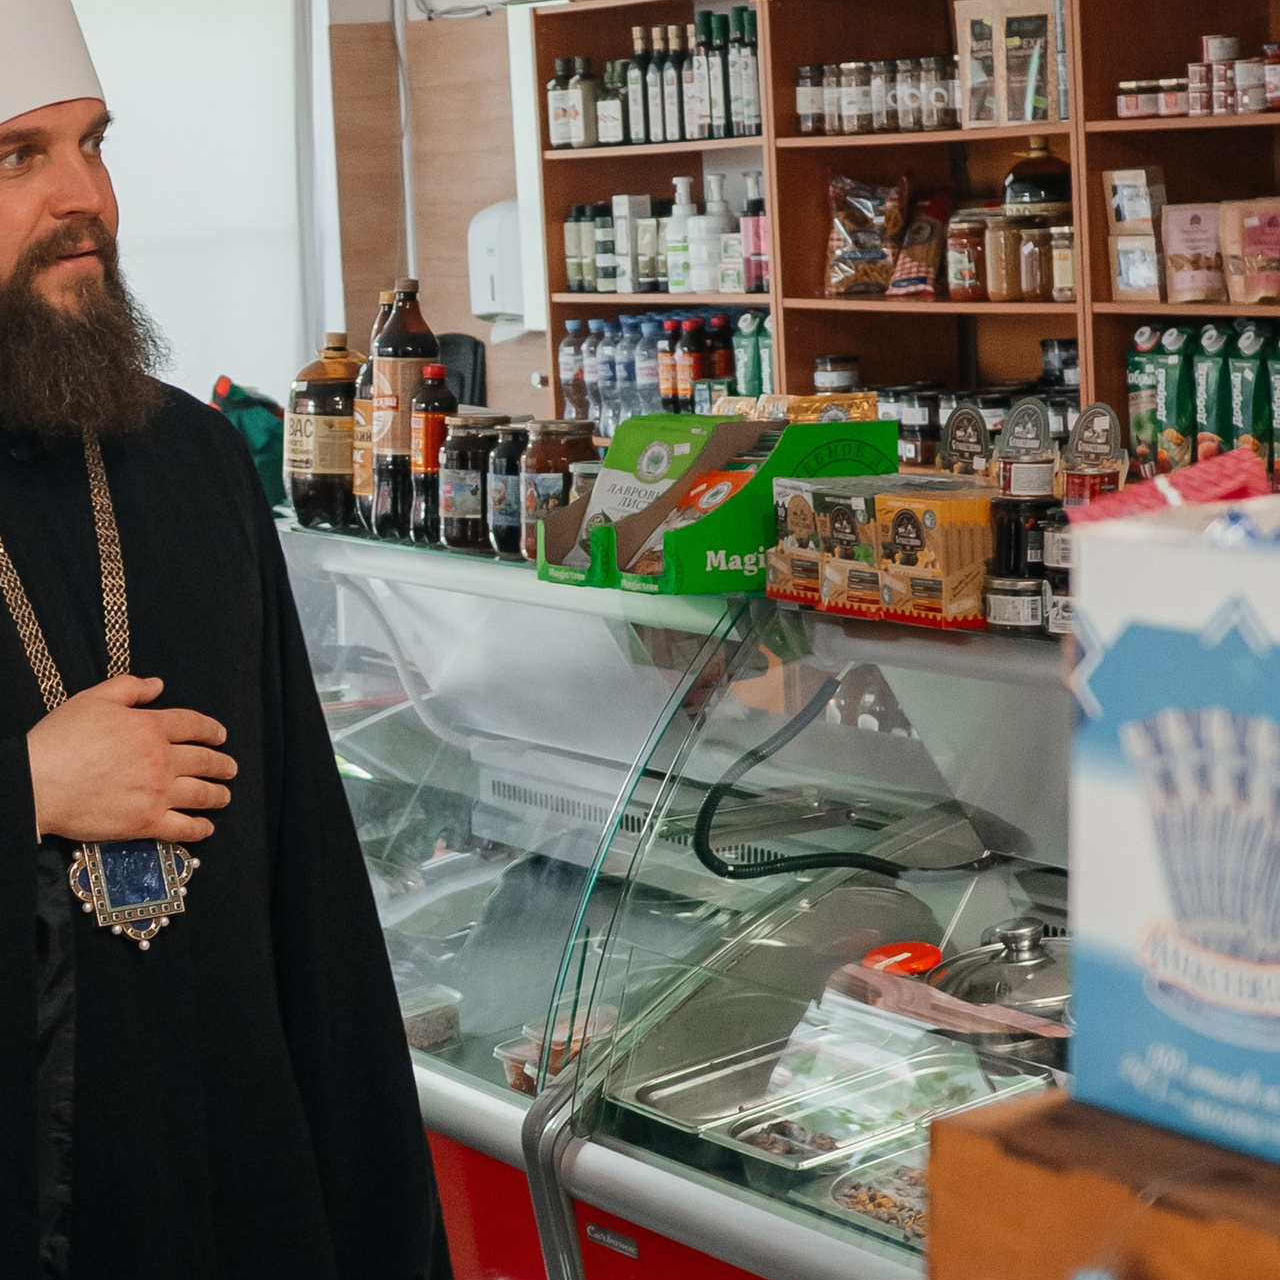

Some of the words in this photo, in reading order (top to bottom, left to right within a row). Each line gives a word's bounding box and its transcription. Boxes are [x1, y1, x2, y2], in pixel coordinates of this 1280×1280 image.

[1155, 368, 1167, 422] Добрый
[1231, 371, 1244, 428] Добрый
[705, 546, 767, 576] Magi
